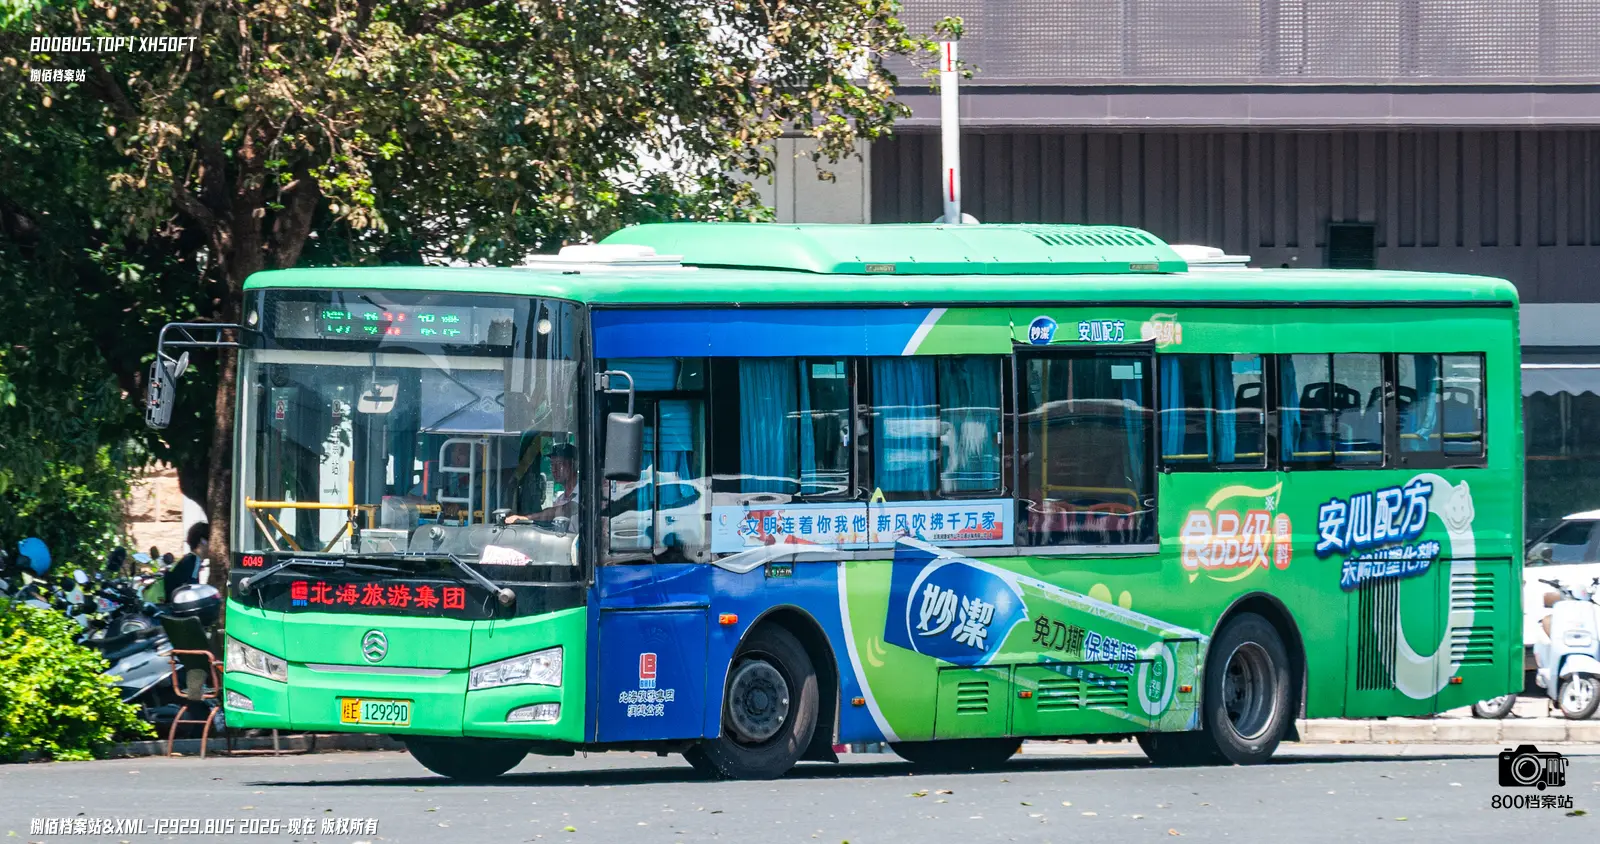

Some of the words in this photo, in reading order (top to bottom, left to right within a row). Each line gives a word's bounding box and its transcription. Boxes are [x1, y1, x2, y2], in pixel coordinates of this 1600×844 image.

[1078, 320, 1125, 342] 安心配方
[745, 514, 868, 536] 文明连着你我他
[1315, 480, 1432, 553] 安心配方
[1180, 511, 1272, 569] 食品级
[242, 555, 263, 567] 6049
[309, 580, 466, 610] 北海旅游集团
[364, 702, 408, 722] 12929D
